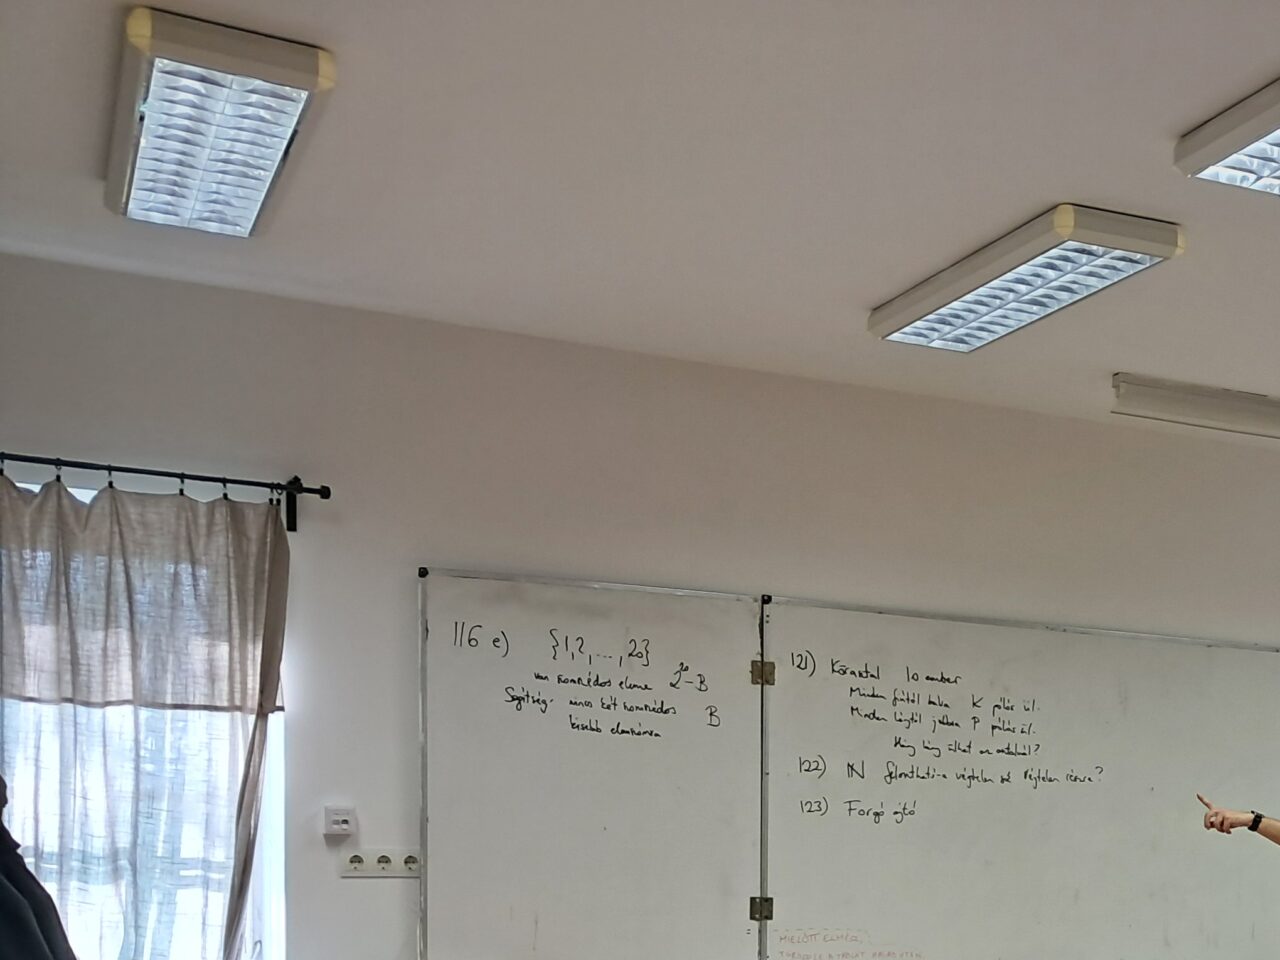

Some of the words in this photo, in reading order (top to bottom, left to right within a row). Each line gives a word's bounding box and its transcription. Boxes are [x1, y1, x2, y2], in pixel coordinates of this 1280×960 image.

[791, 649, 817, 678] 121)
[704, 704, 721, 728] B
[799, 754, 827, 779] 122)
[800, 796, 829, 817] 123)
[843, 799, 885, 825] Forgó
